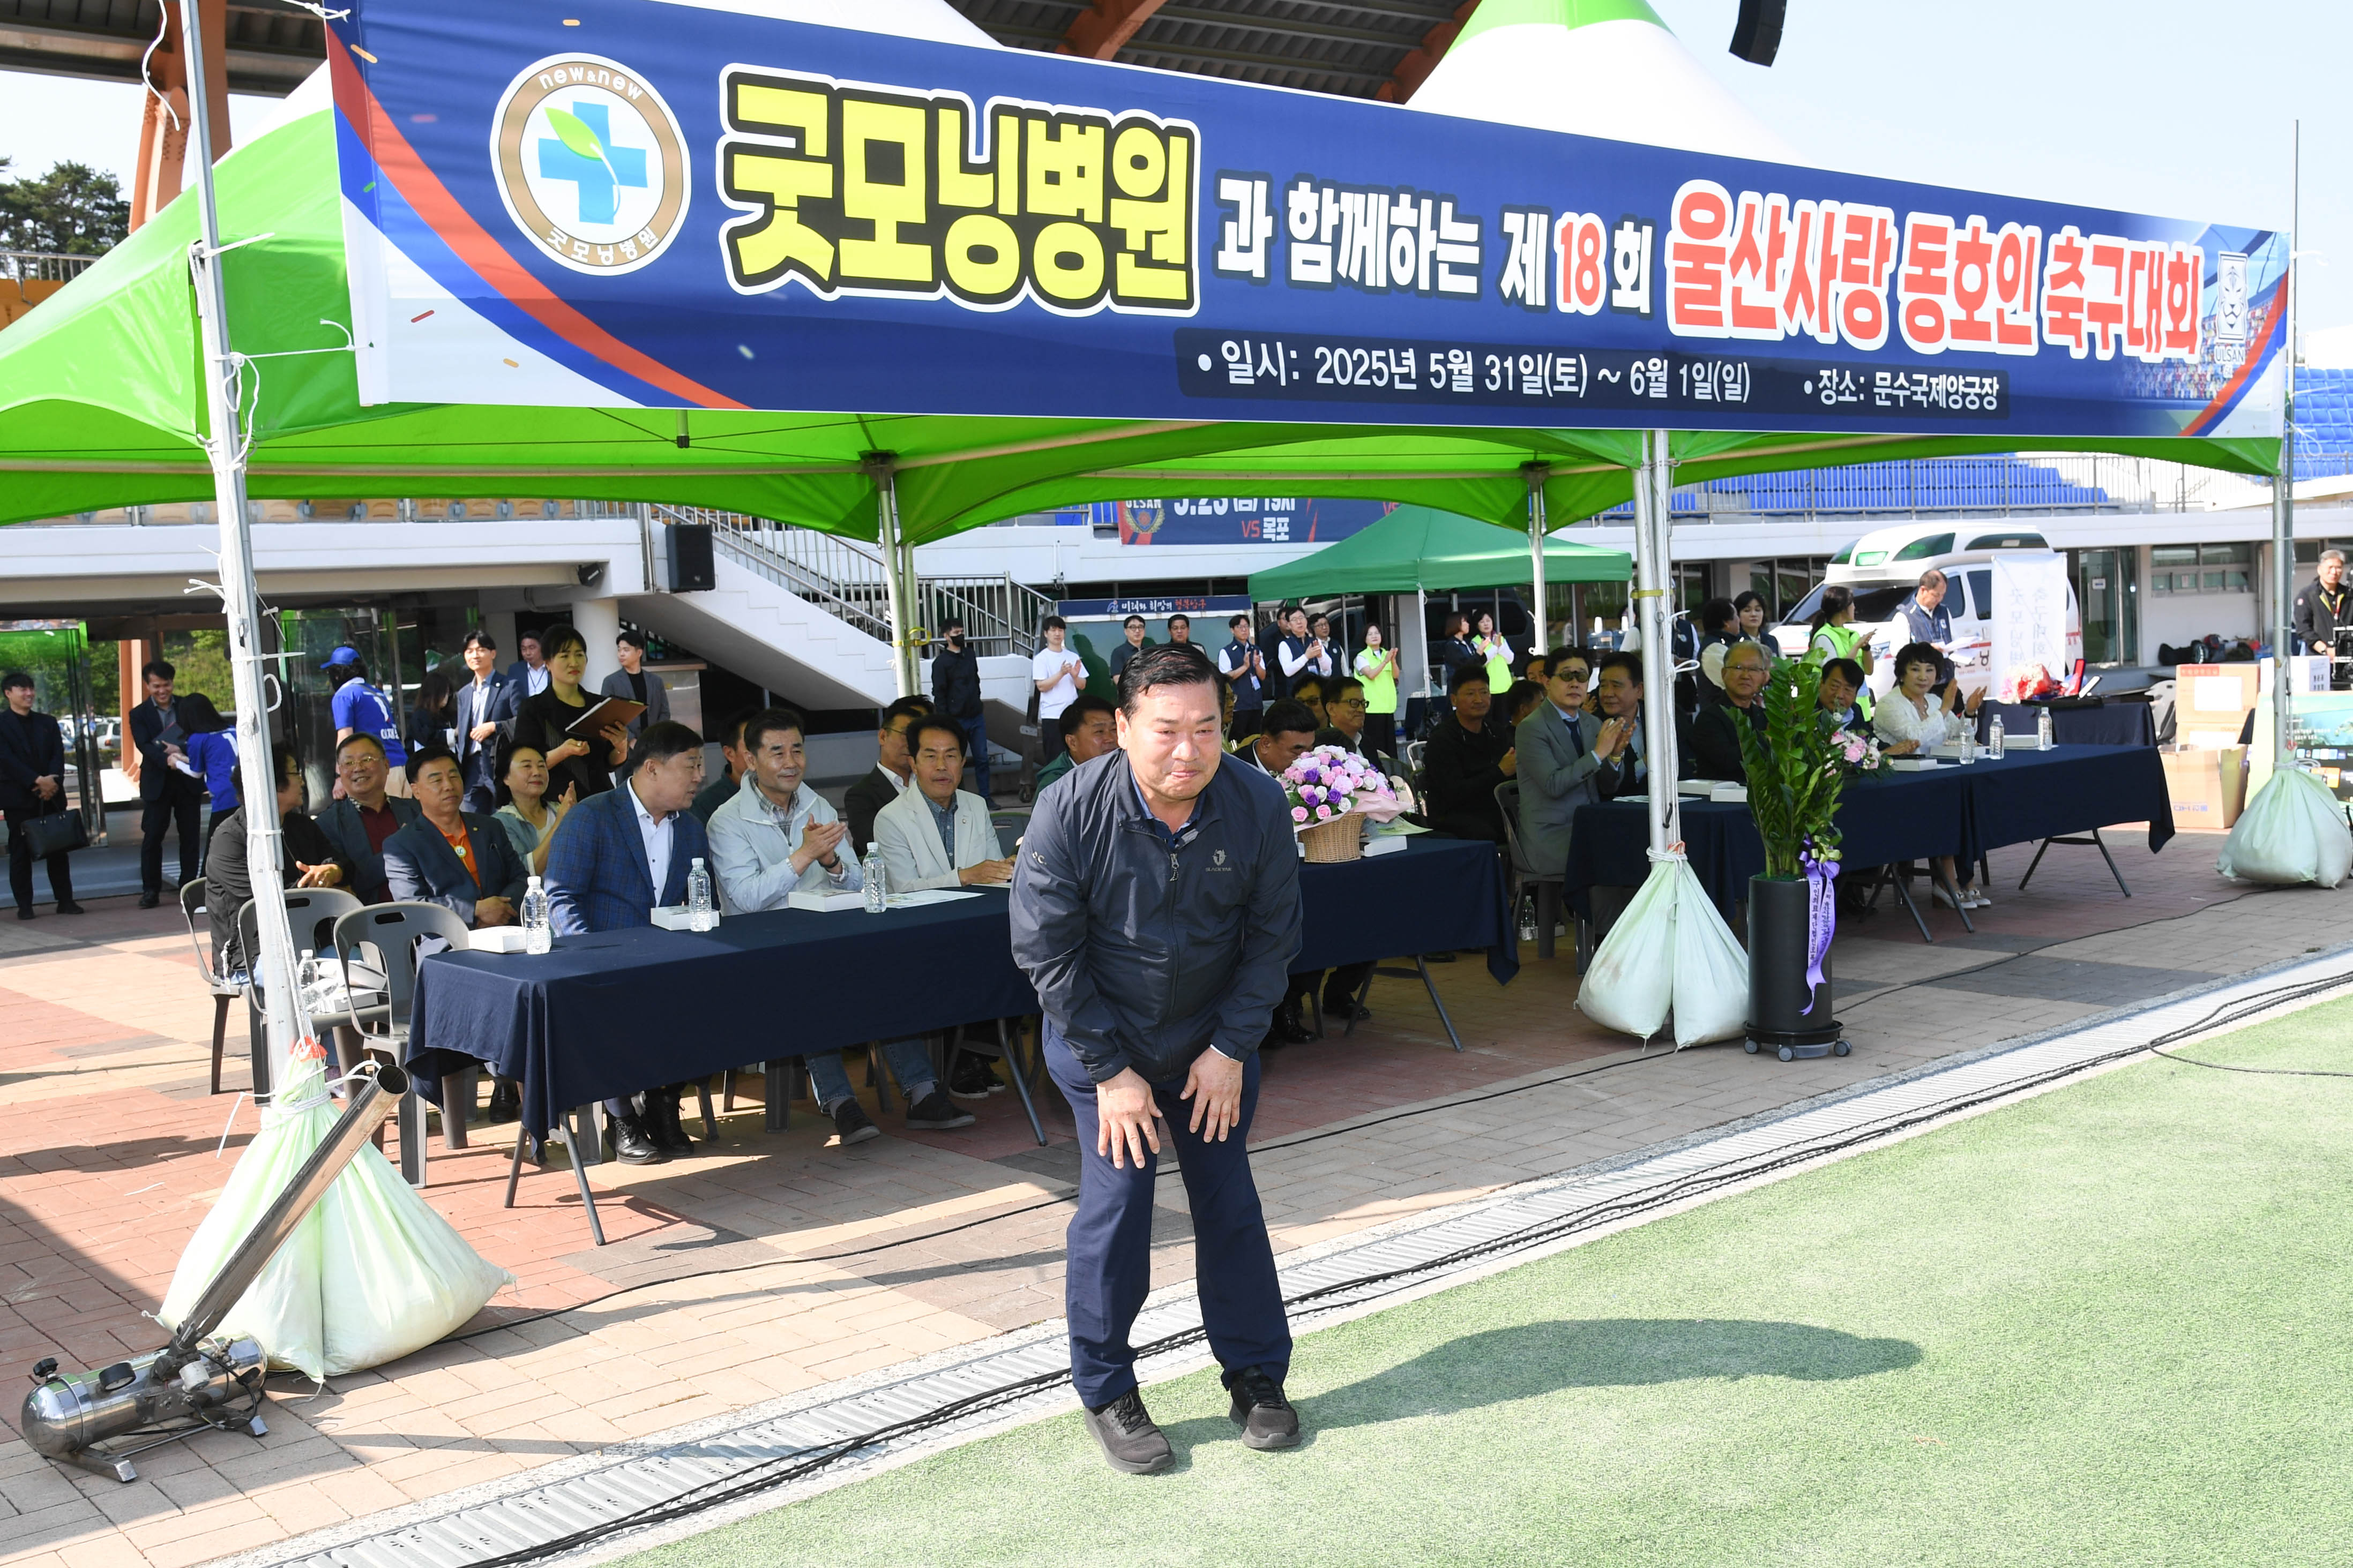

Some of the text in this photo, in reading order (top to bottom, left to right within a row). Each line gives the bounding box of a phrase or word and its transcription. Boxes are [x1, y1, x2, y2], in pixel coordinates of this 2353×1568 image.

[540, 65, 643, 101] new&new
[723, 72, 2201, 358] 굿모닝병원 과 함께하는 제18회 울산사랑 동호인 축구대회
[546, 226, 659, 266] 굿모닝병원
[1221, 340, 1299, 386] 일시:
[1314, 346, 1417, 390] 2025년
[1430, 349, 1474, 393] 5월
[1485, 352, 1588, 399] 31일(토)
[1630, 357, 1668, 399] 6월
[1679, 361, 1750, 403] 1일(일)
[2215, 349, 2244, 362] ULSAN
[1818, 368, 1999, 411] 장소: 문수국제양궁장
[1242, 516, 1289, 542] VS 목포
[1122, 600, 1147, 612] 미래와
